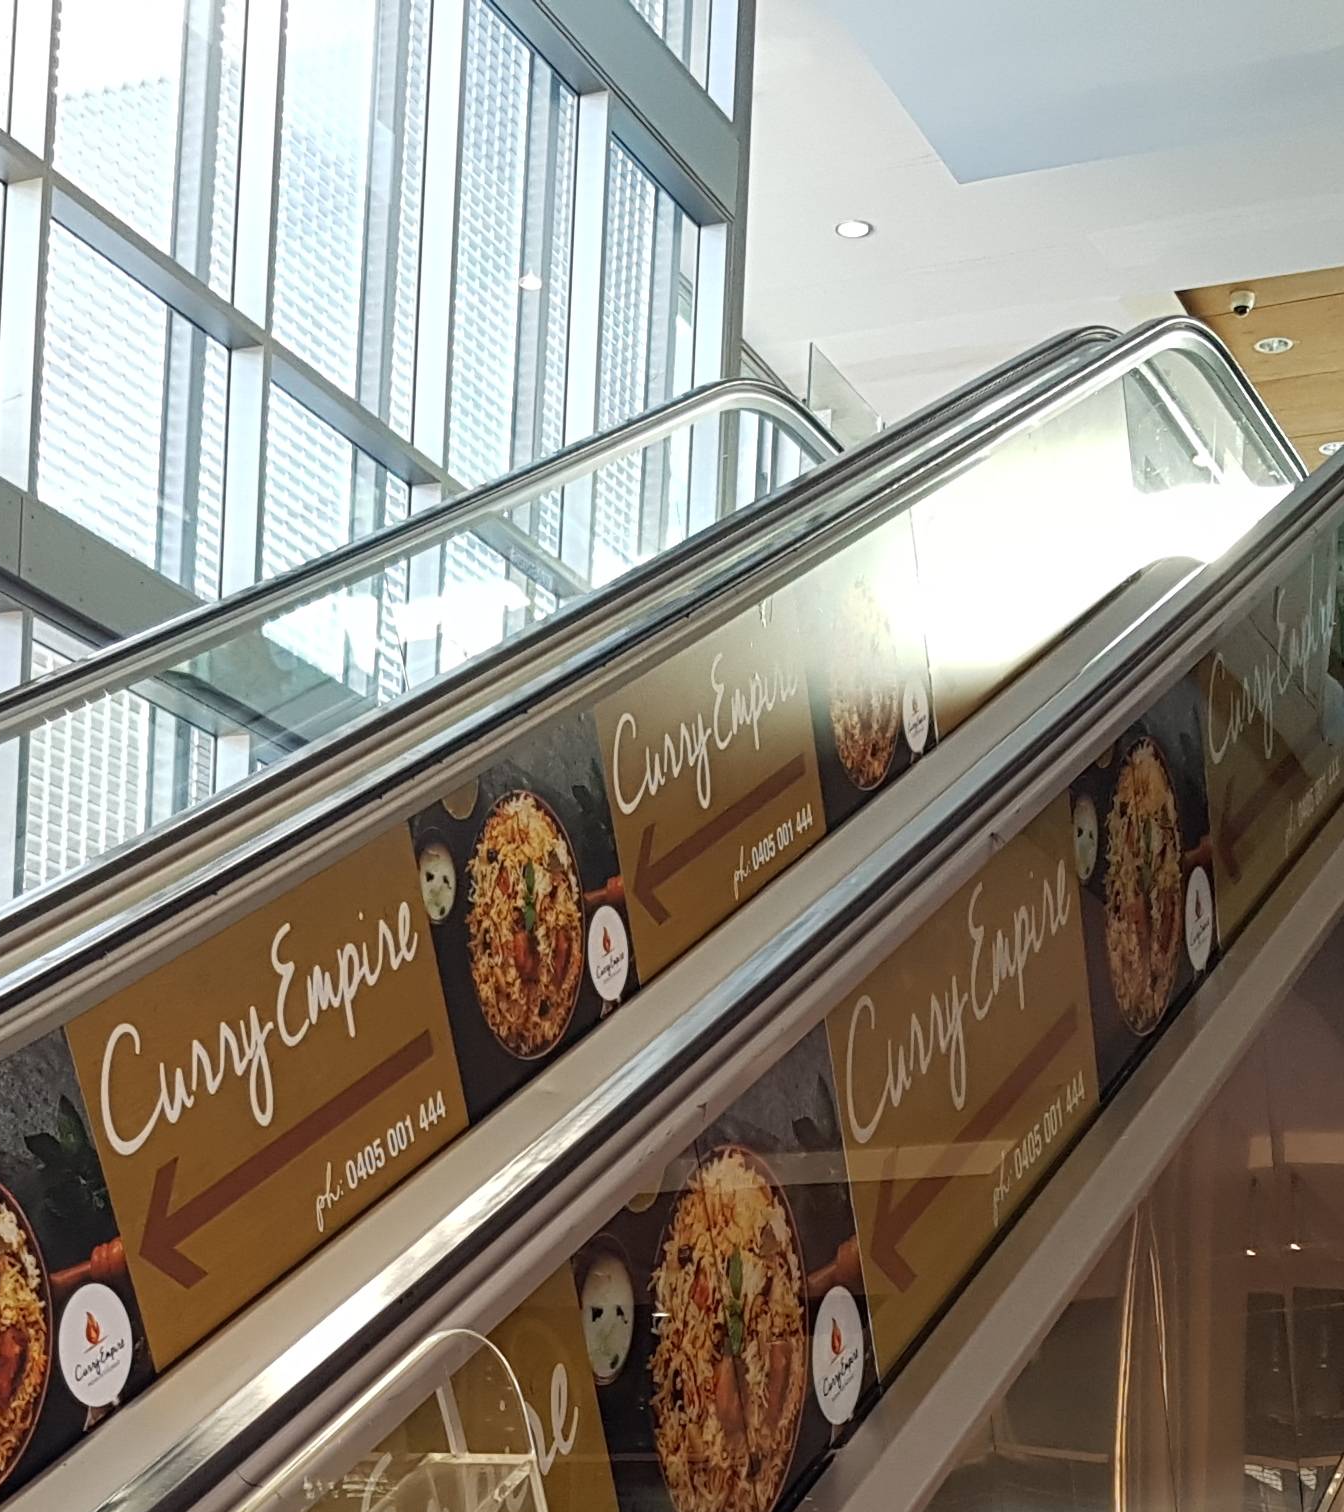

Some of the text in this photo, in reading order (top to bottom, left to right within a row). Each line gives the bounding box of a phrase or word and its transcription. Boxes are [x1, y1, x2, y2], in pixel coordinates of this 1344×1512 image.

[613, 712, 712, 815] Curry
[733, 803, 814, 901] ph: 0405 001 444
[100, 901, 418, 1156] Curry Empire
[846, 859, 1071, 1144] Curry Empire
[314, 1089, 448, 1232] ph: 0405 001 444
[1014, 1123, 1043, 1181] 0405
[1043, 1104, 1064, 1145] 001
[1065, 1070, 1087, 1114] 444
